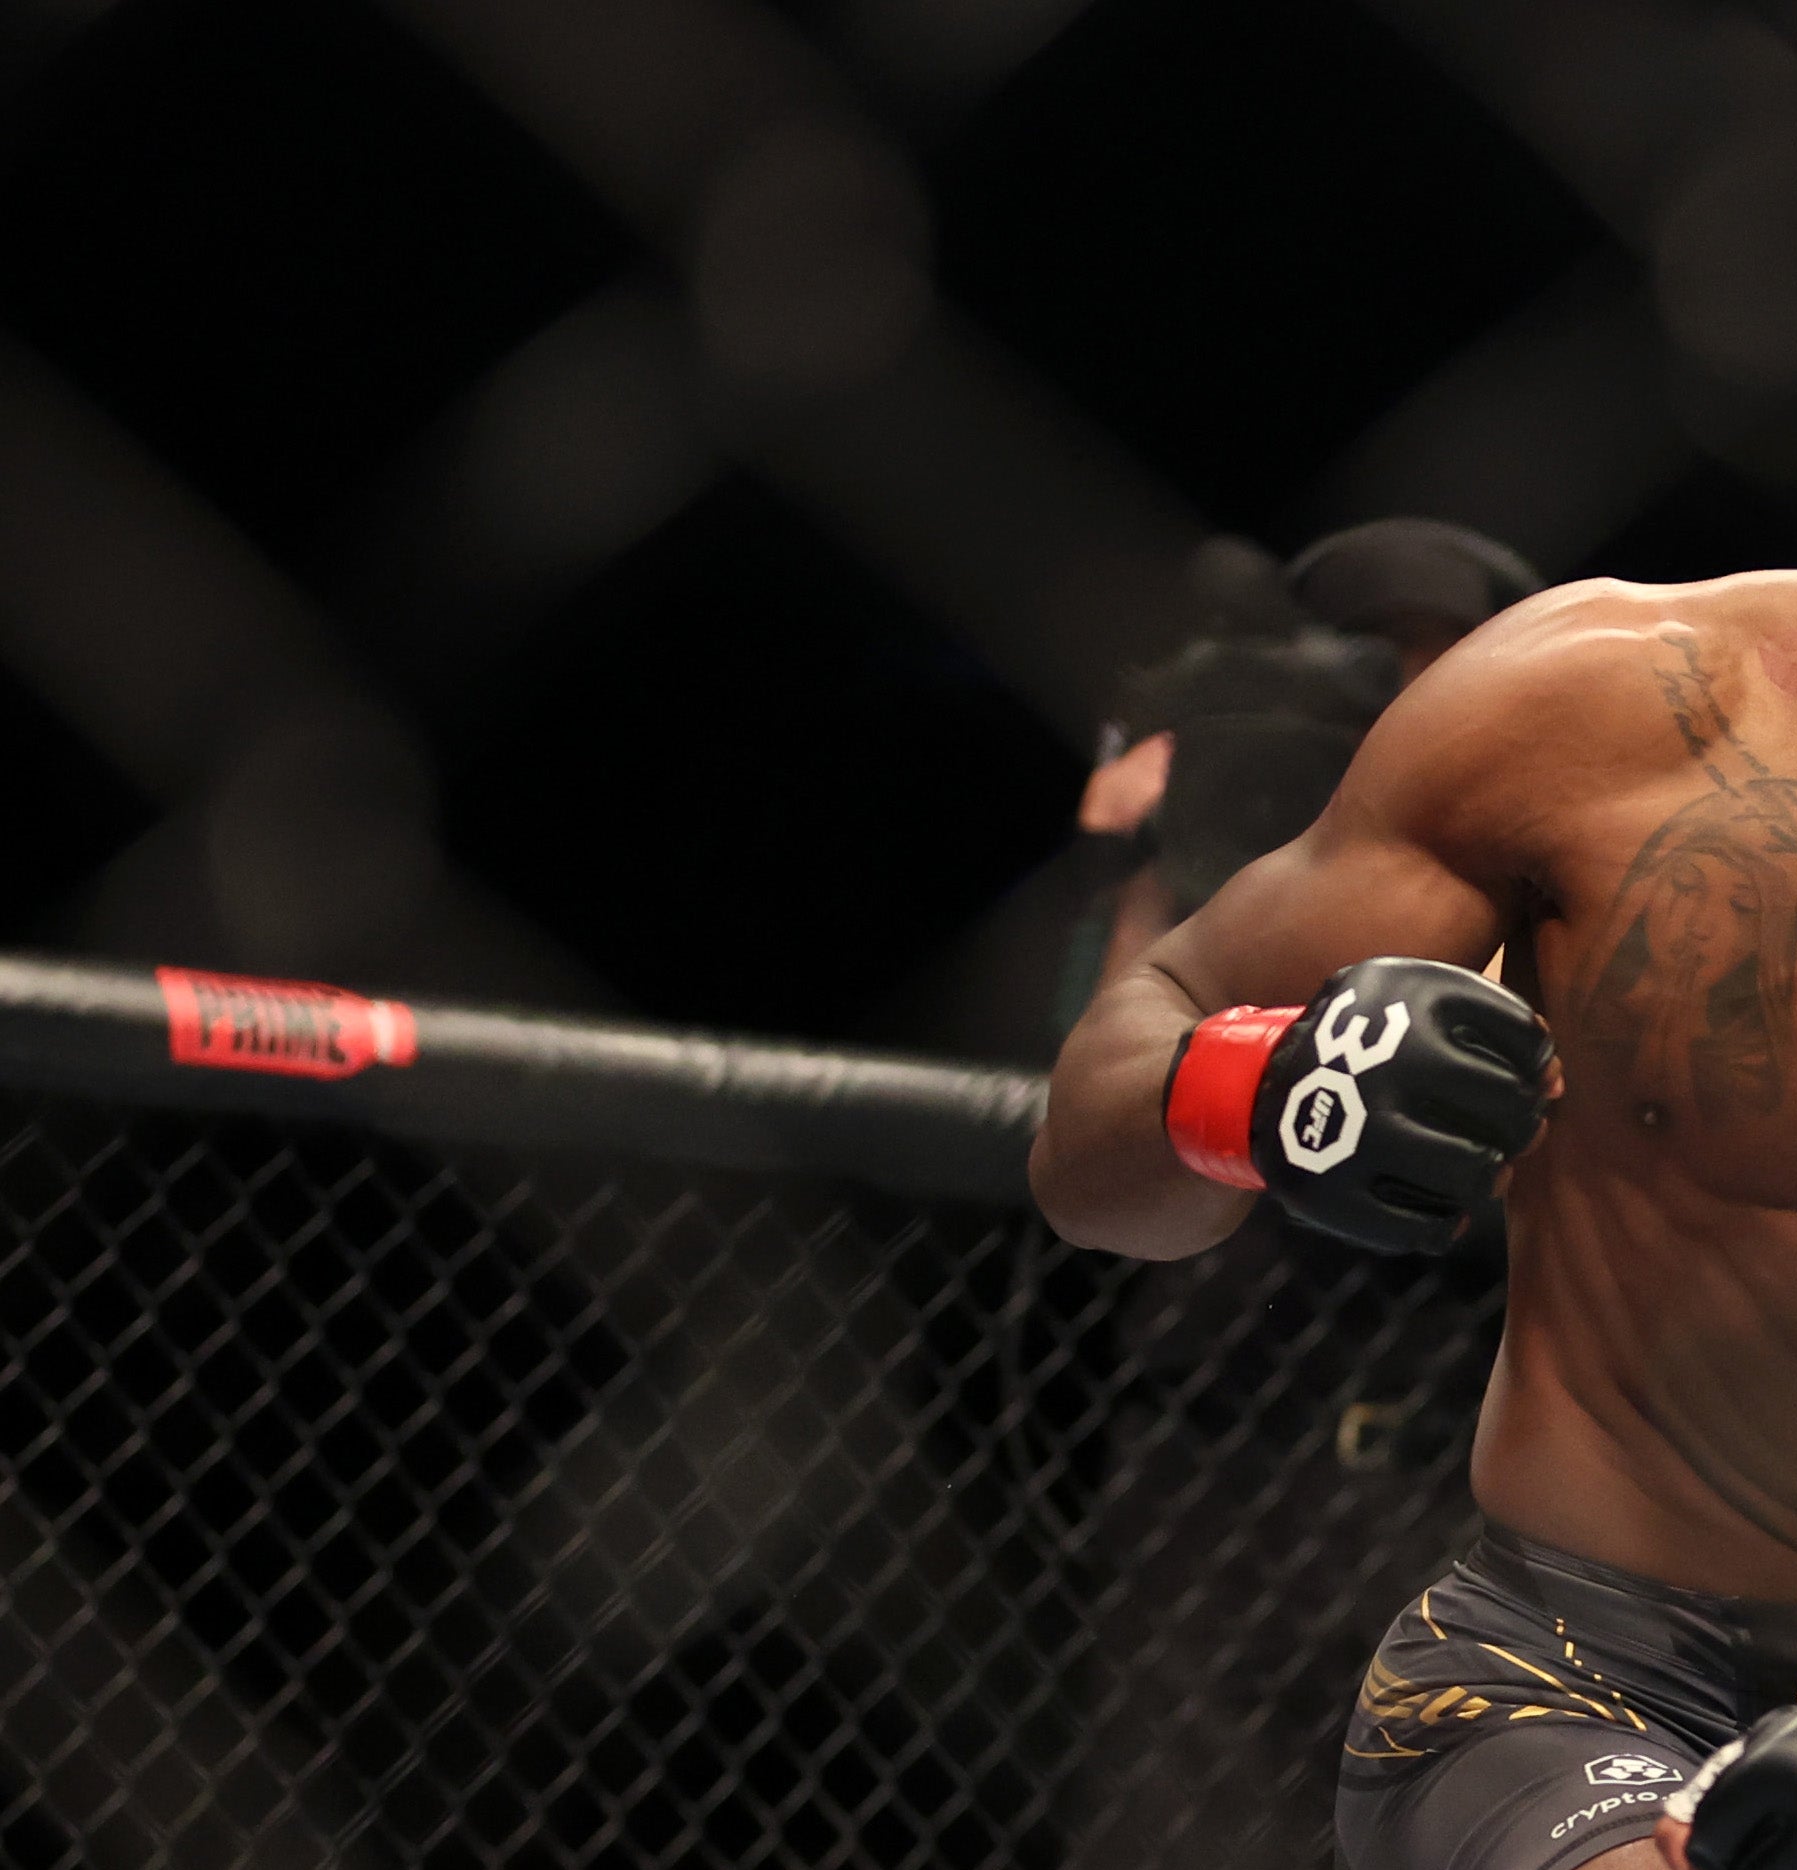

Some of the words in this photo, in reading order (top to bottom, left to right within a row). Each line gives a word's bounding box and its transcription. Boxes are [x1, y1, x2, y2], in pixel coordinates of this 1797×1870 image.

[1279, 988, 1411, 1175] 30
[1302, 1089, 1335, 1150] UFC
[1550, 1790, 1671, 1841] crypto.
